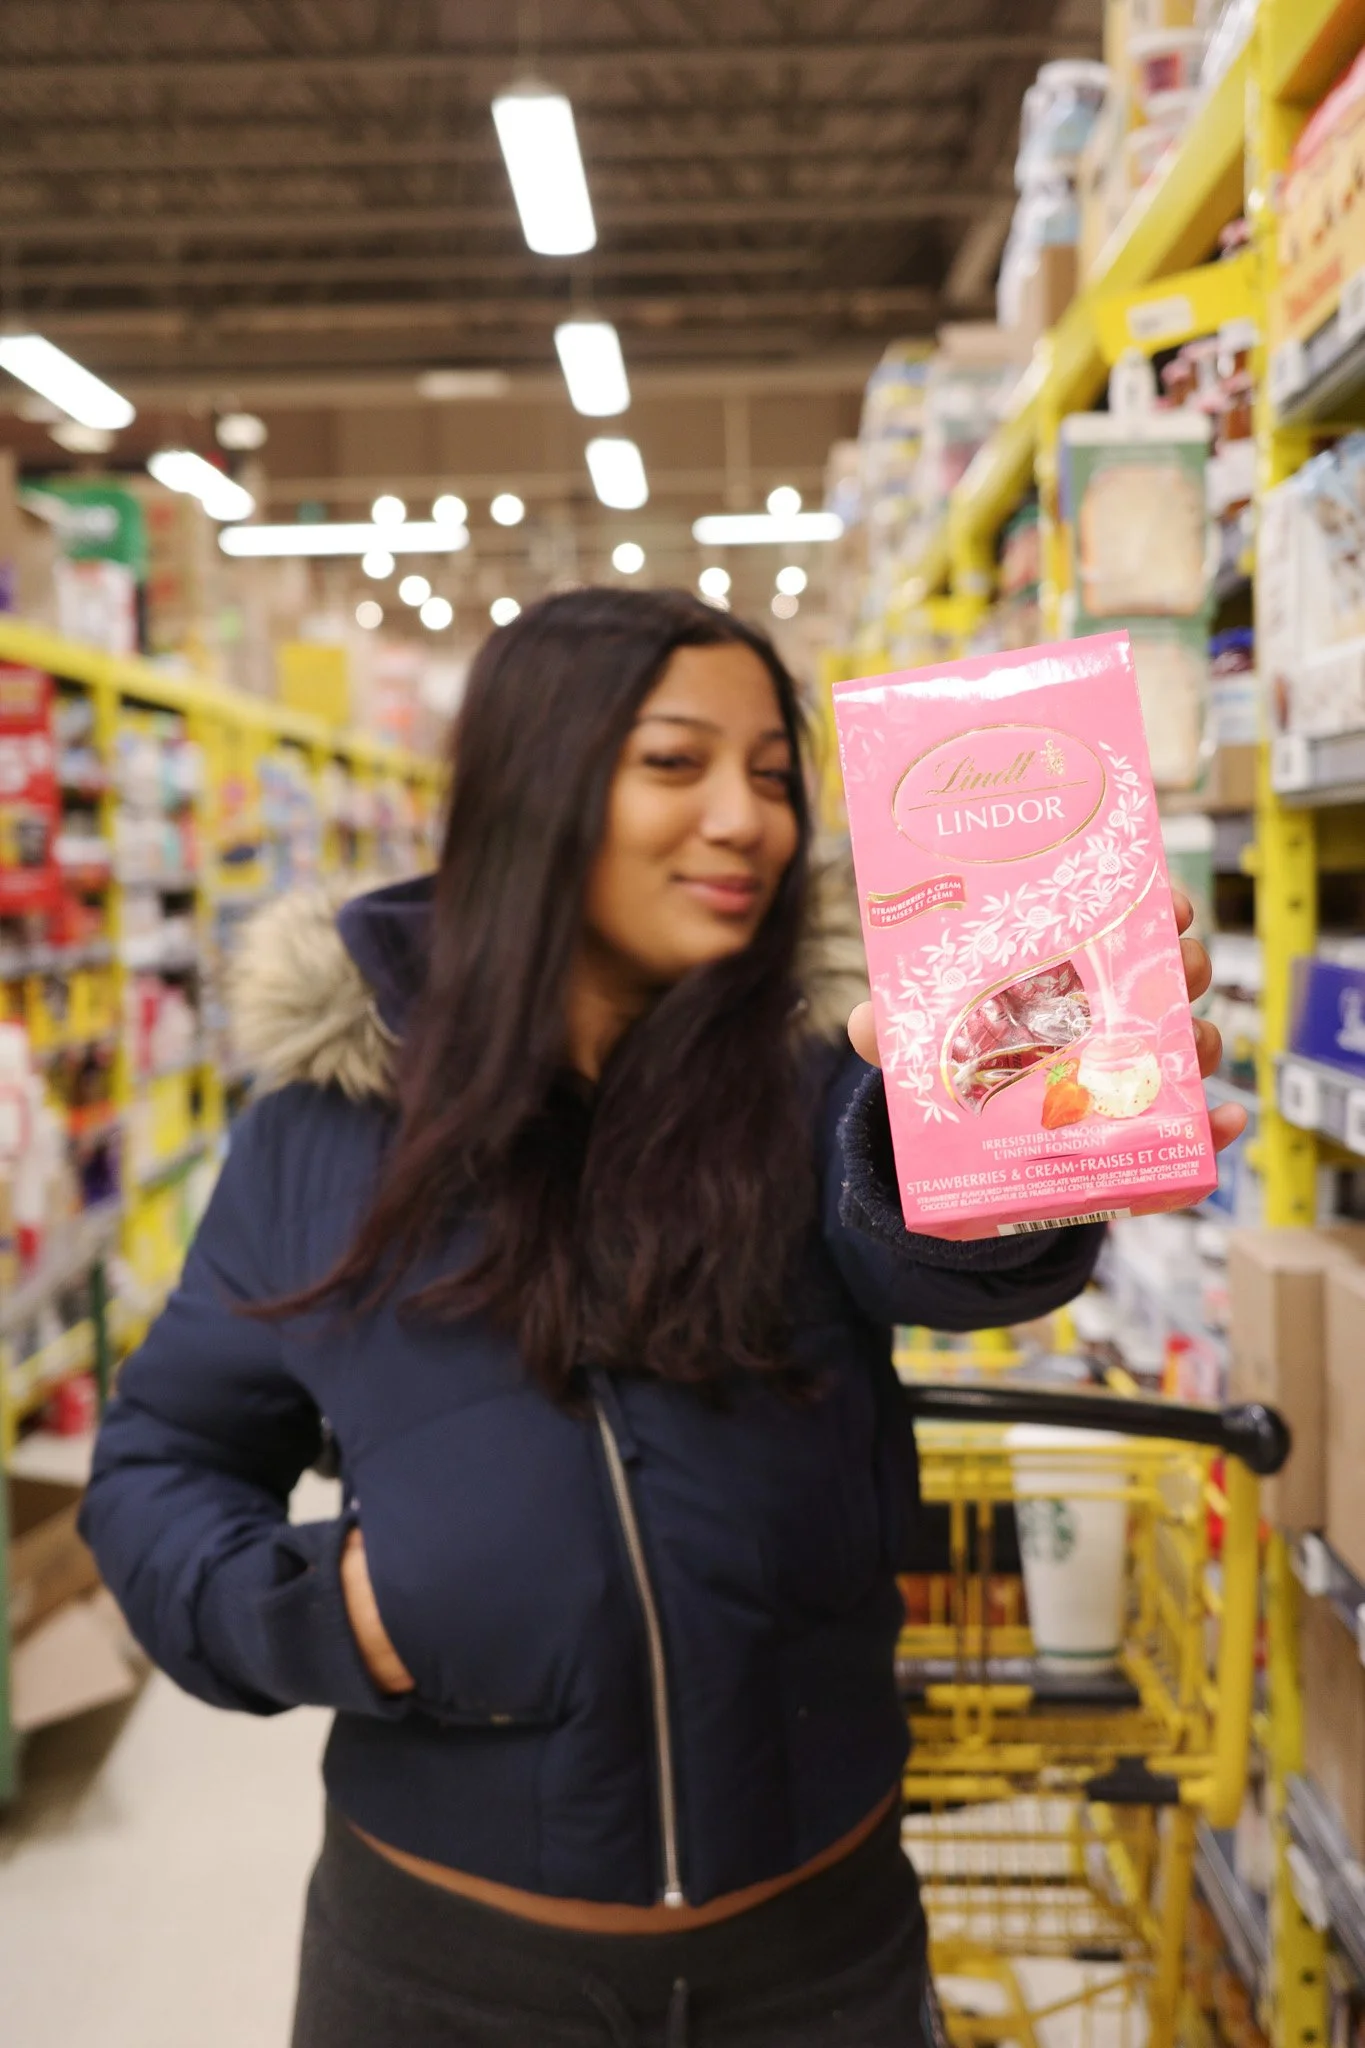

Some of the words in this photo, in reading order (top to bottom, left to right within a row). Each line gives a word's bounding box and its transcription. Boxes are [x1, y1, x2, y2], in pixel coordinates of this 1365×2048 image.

[926, 750, 1036, 795] Lindt
[936, 796, 1066, 836] LINDOR
[872, 890, 925, 915] STRAWBERRIES
[934, 881, 961, 891] CREAM
[881, 906, 913, 923] FRAISES
[915, 900, 924, 910] ET
[982, 1131, 1057, 1151] IRRESISTIBLY
[1157, 1123, 1181, 1139] 150
[1184, 1124, 1194, 1139] g
[993, 1145, 1041, 1160] L'INFINI
[1046, 1137, 1107, 1153] FONDANT
[906, 1169, 1007, 1195] STRAWBERRIES
[1011, 1169, 1021, 1181] &
[1137, 1150, 1154, 1163] ET
[1158, 1142, 1206, 1161] CRÈME
